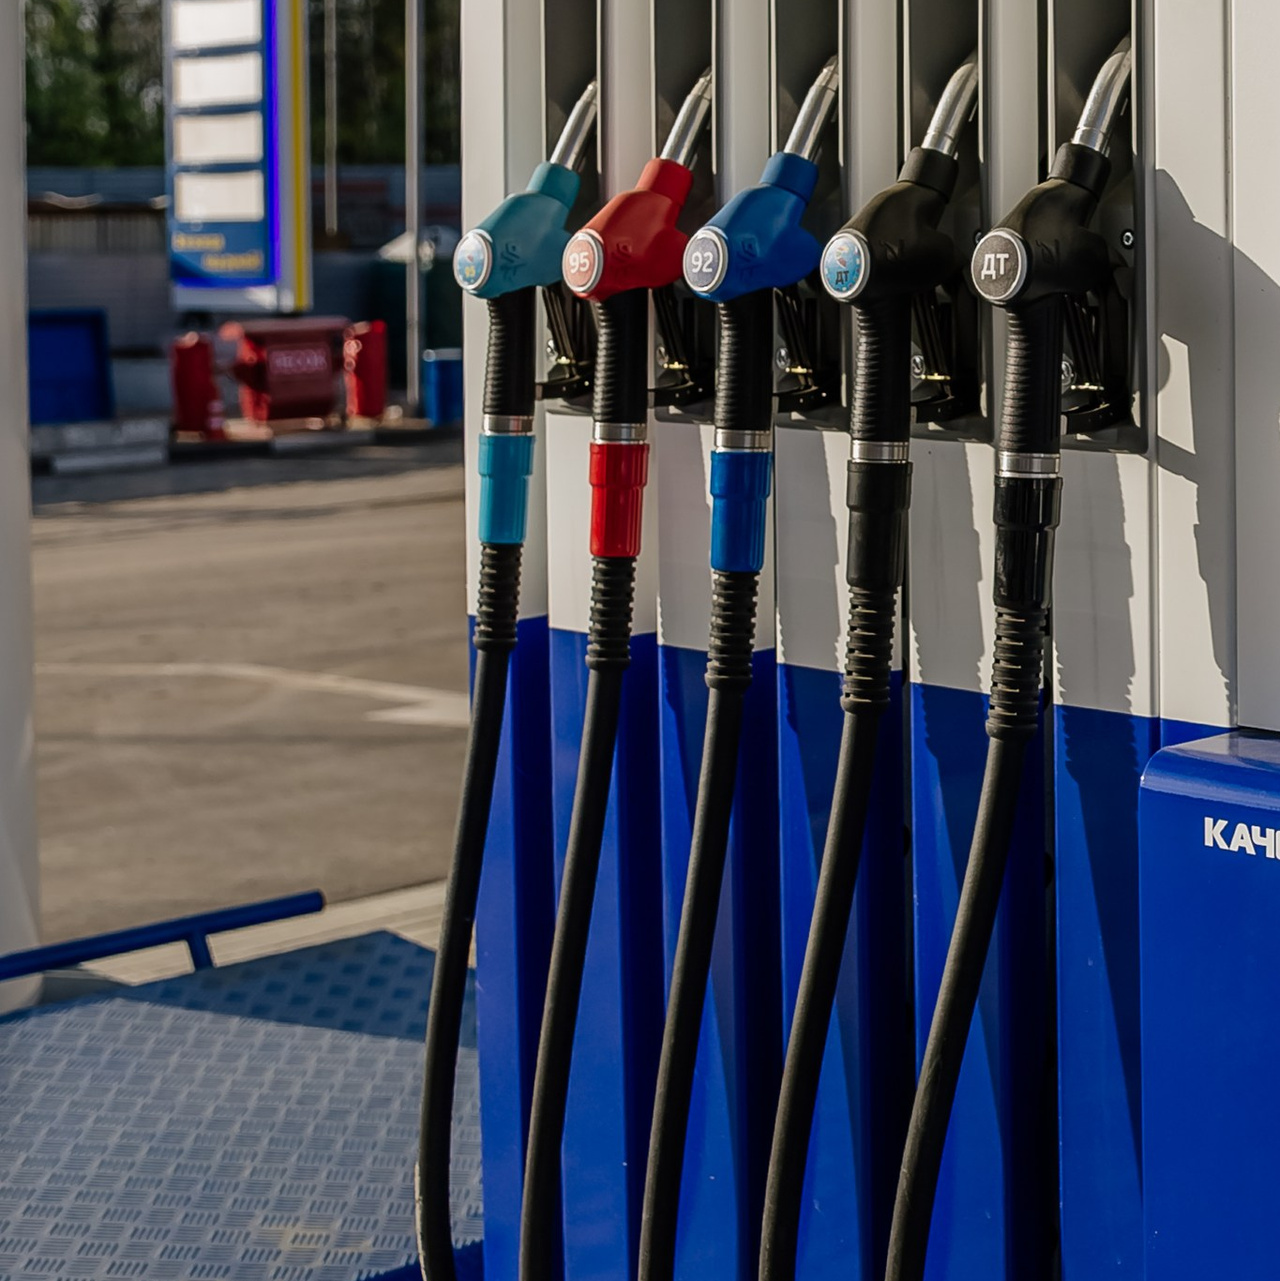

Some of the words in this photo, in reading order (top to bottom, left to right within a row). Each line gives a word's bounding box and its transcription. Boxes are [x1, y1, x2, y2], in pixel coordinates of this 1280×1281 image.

[568, 251, 590, 273] 95
[691, 250, 713, 273] 92
[981, 253, 1010, 280] ДТ
[835, 269, 850, 286] ДТ
